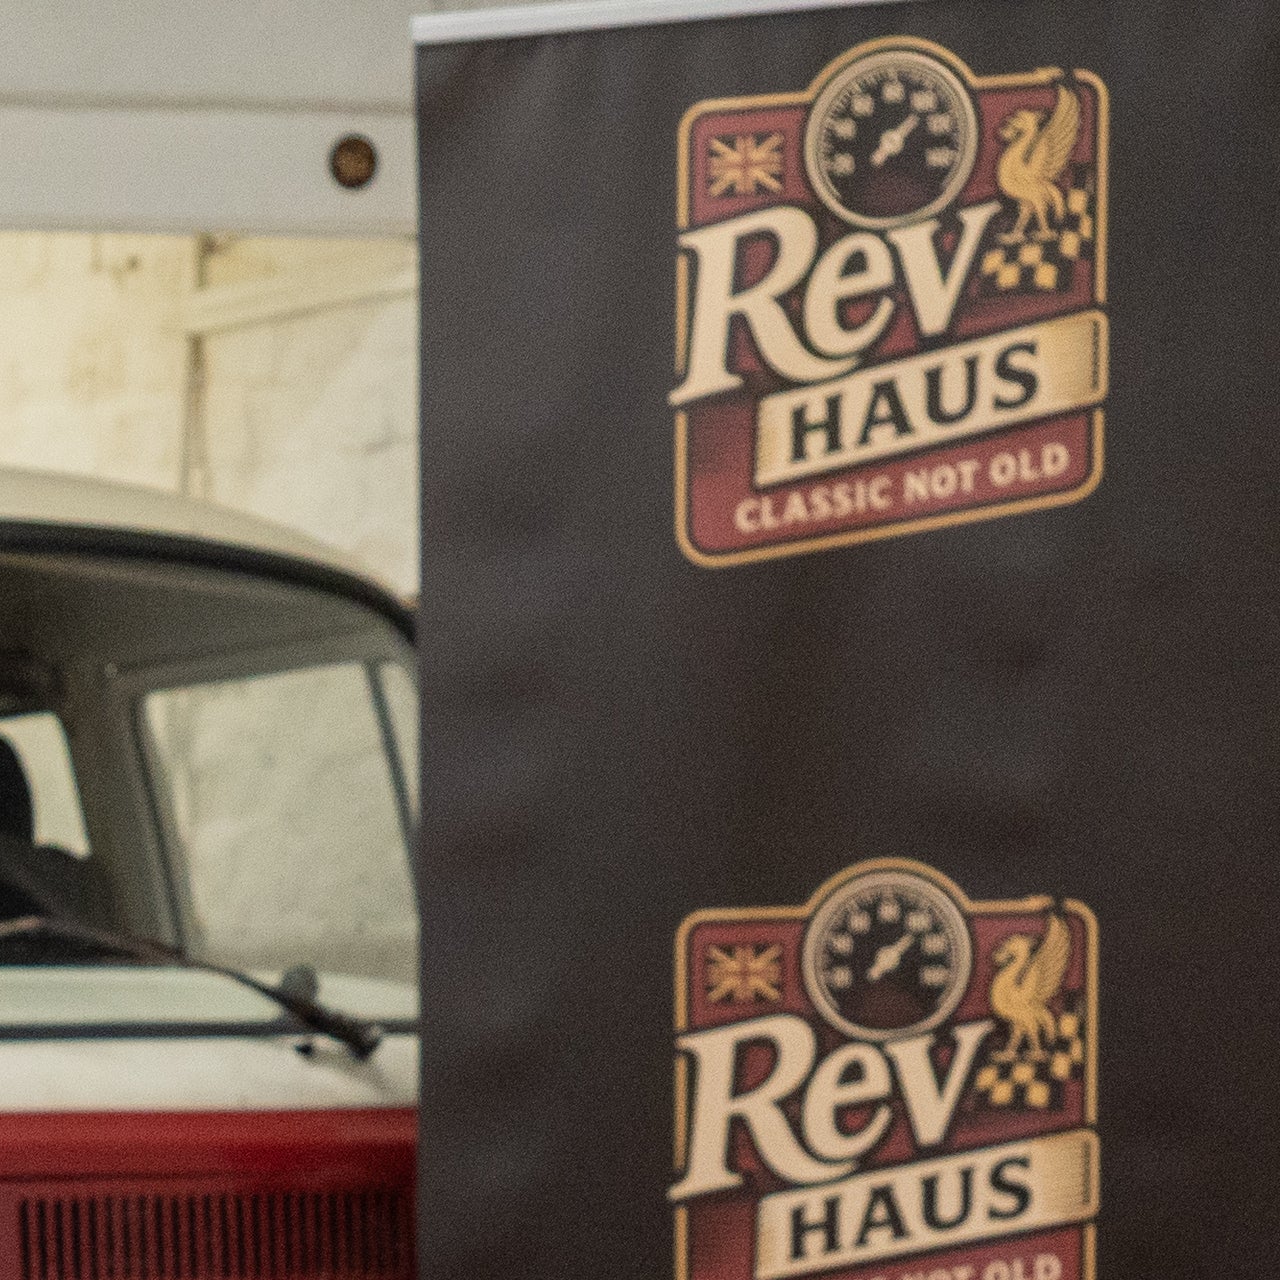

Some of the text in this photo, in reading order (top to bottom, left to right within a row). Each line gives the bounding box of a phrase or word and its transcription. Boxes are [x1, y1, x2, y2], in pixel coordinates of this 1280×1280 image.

[669, 201, 1001, 405] Rev
[788, 341, 1040, 465] HAUS
[734, 443, 1071, 533] CLASSIC NOT OLD
[666, 1012, 996, 1201] Rev
[789, 1156, 1032, 1263] HAUS
